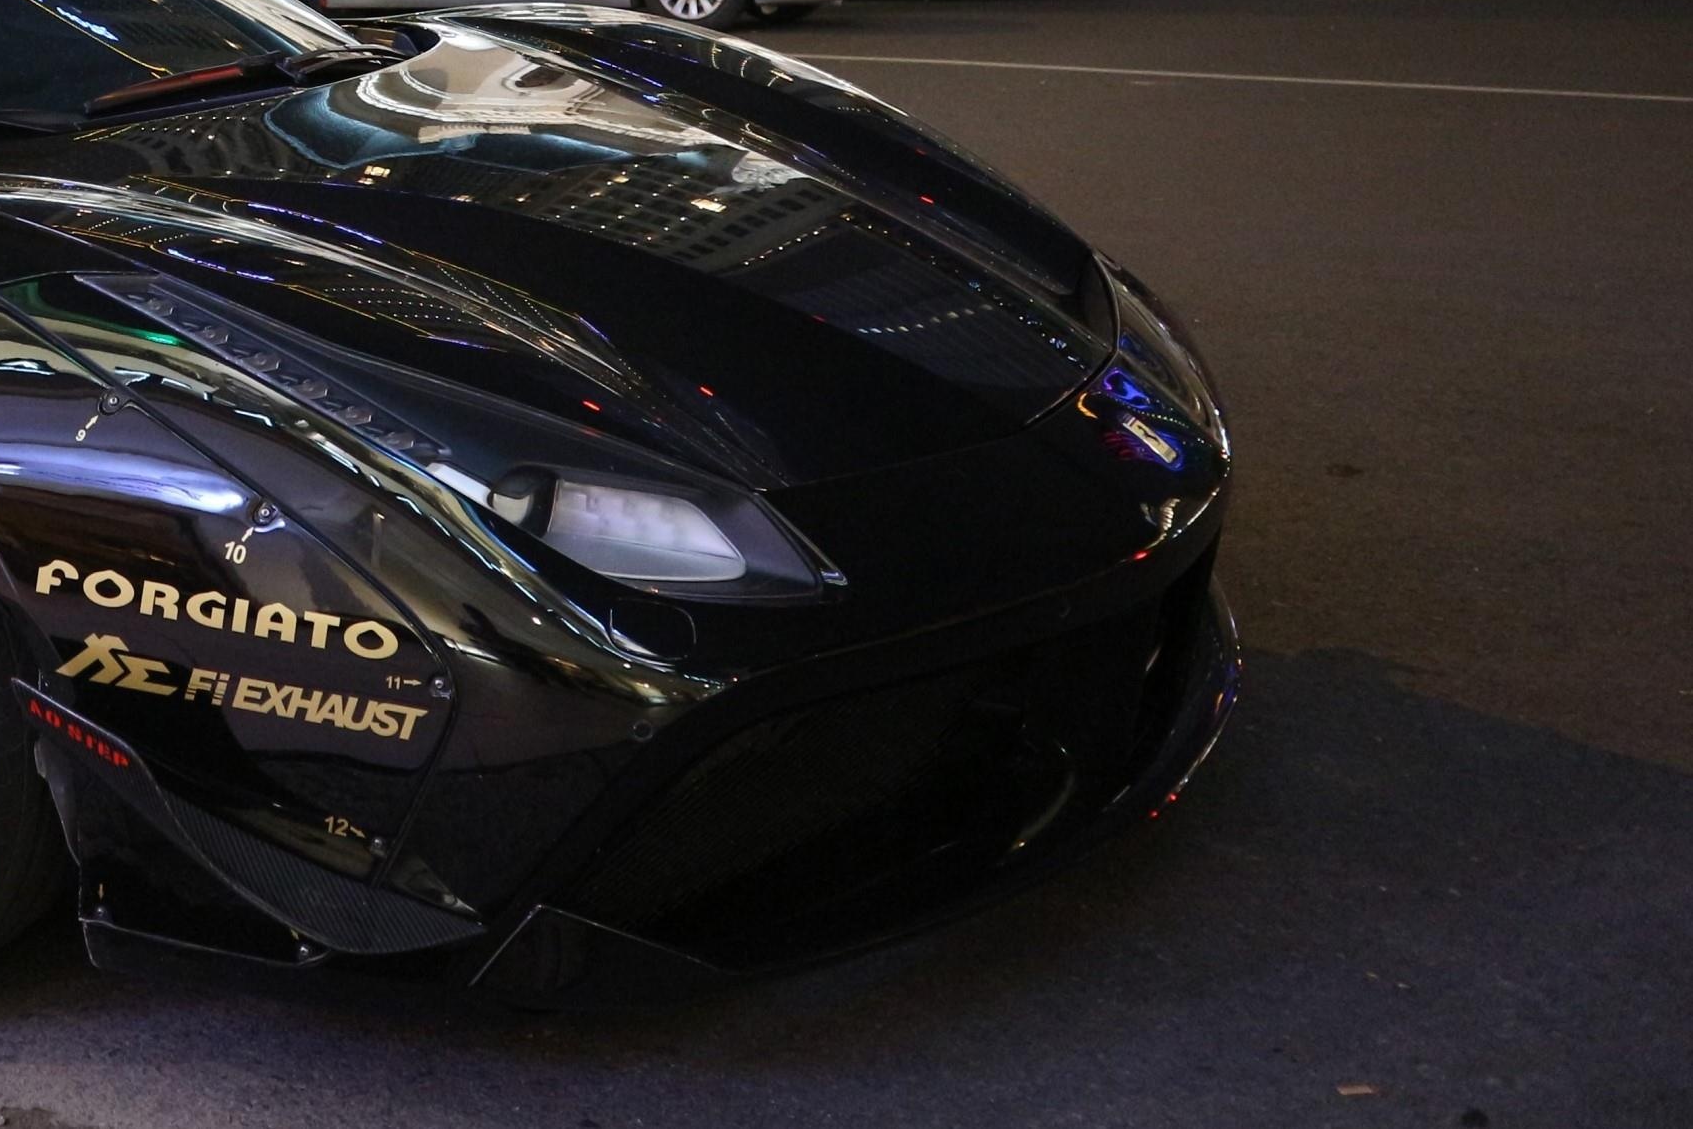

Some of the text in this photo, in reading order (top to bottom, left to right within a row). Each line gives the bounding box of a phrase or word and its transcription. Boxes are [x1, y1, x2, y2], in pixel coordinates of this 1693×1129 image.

[75, 429, 87, 442] 9
[224, 540, 247, 565] 10
[35, 559, 399, 660] FORGIATO
[385, 675, 402, 691] 11
[232, 677, 428, 741] EXHAUST
[323, 815, 350, 838] 12
